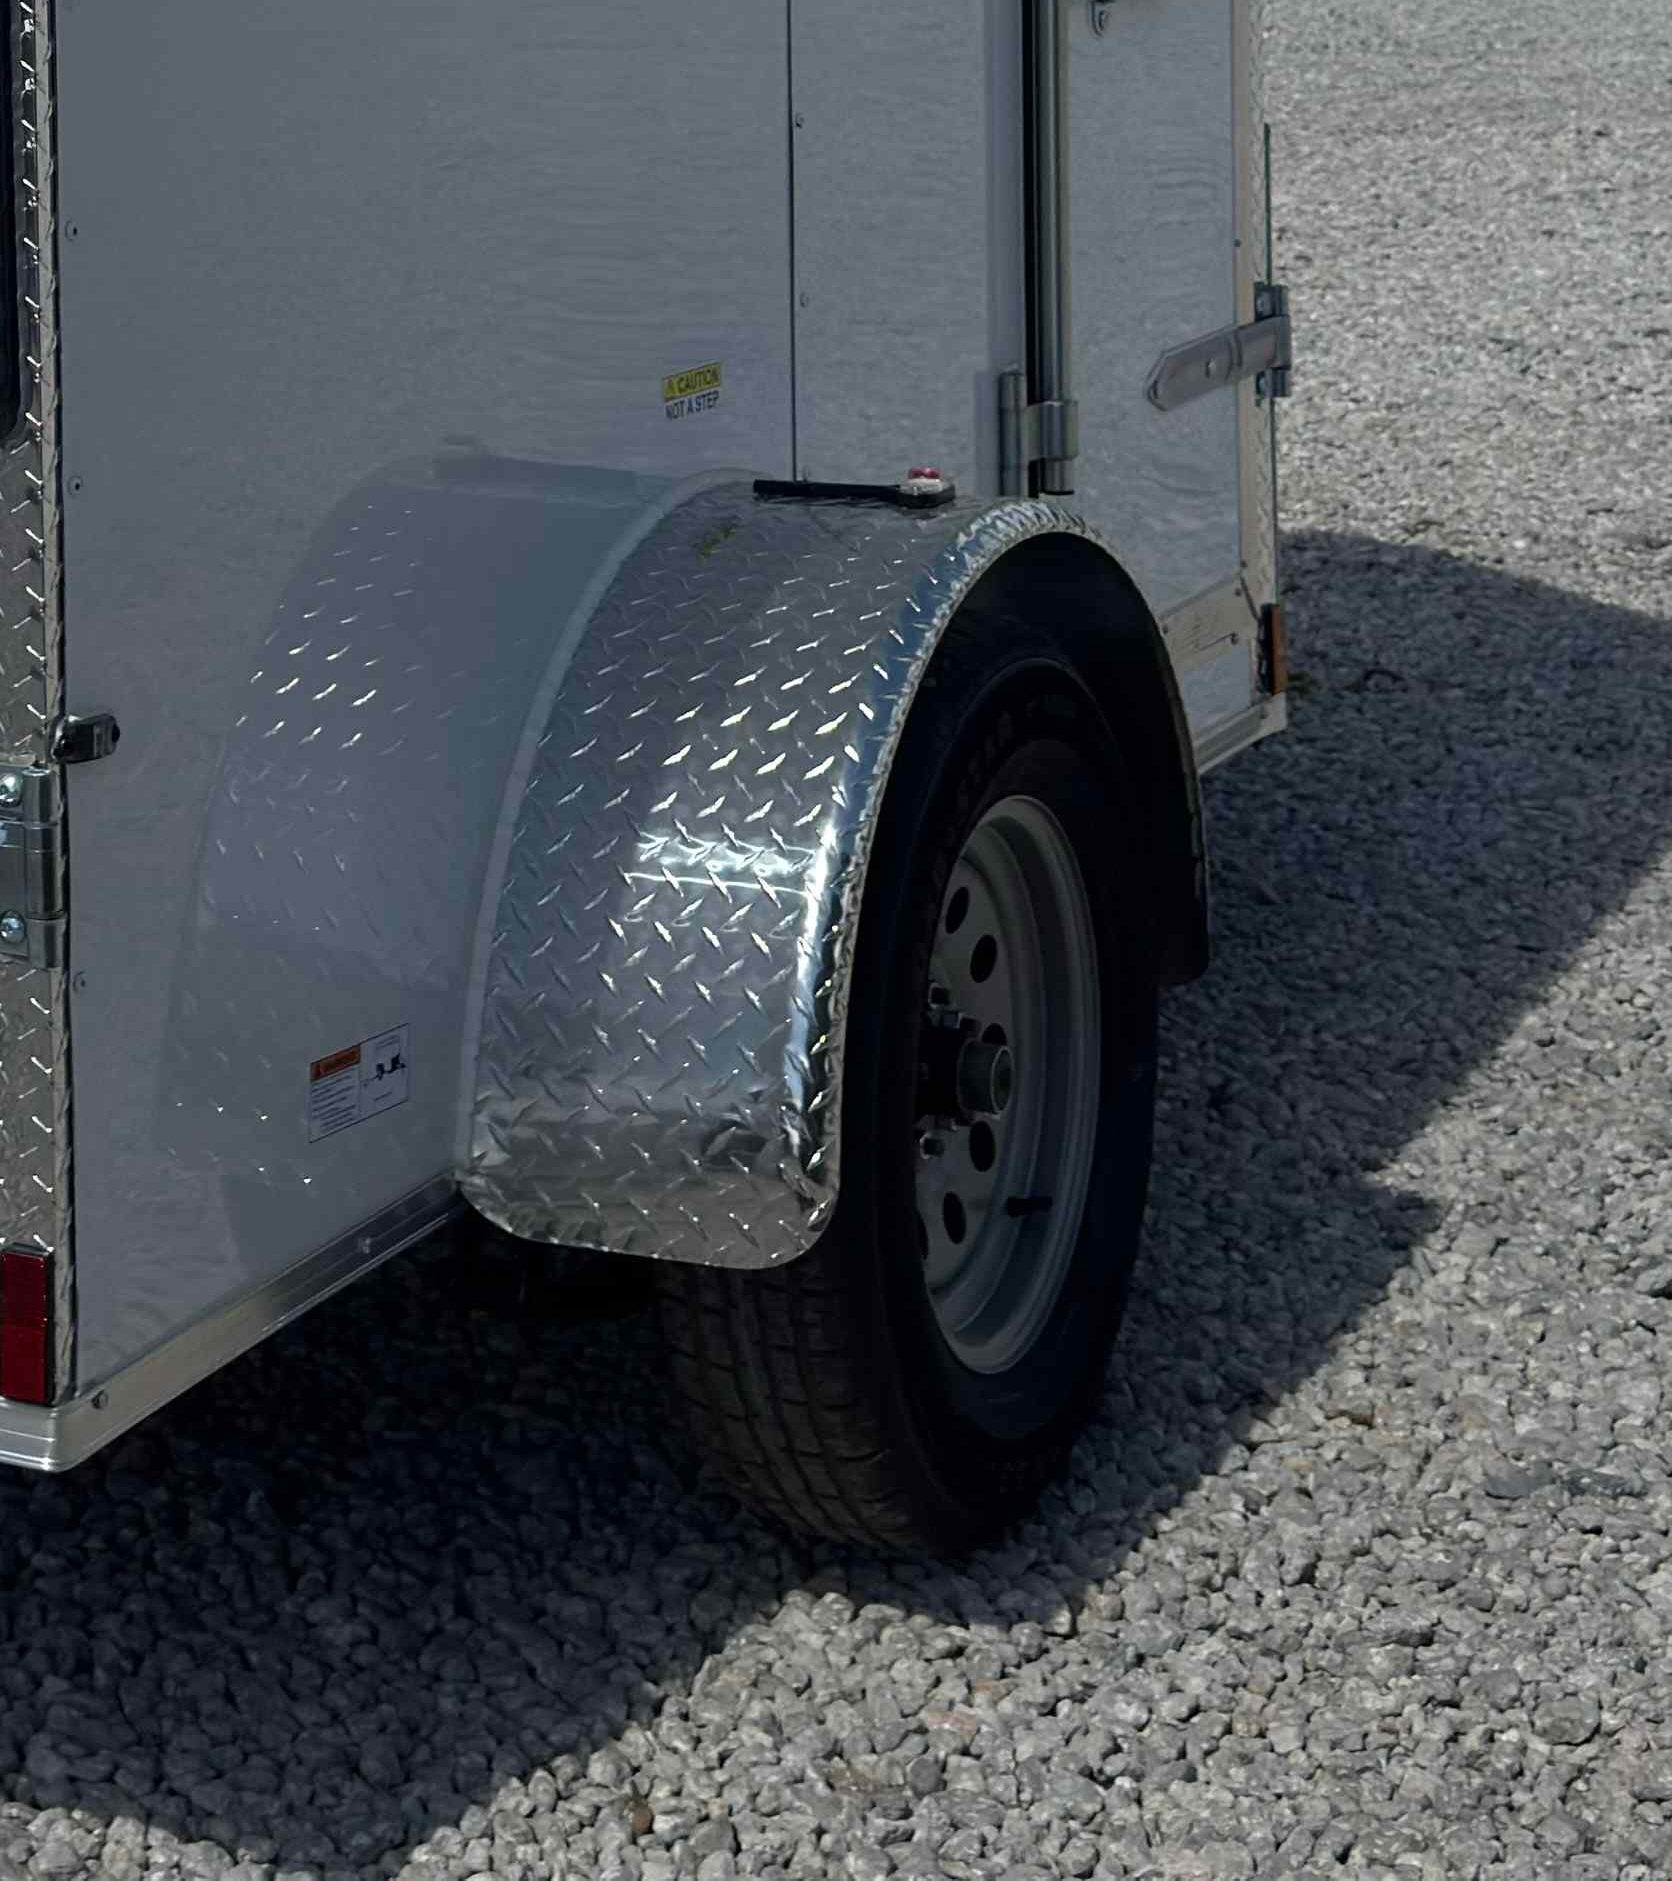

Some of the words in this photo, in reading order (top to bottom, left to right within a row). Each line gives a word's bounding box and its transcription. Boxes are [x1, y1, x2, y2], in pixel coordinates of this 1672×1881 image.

[678, 368, 719, 394] CAUTION
[665, 399, 685, 421] NOT
[687, 398, 694, 416] A
[695, 390, 719, 412] STEP
